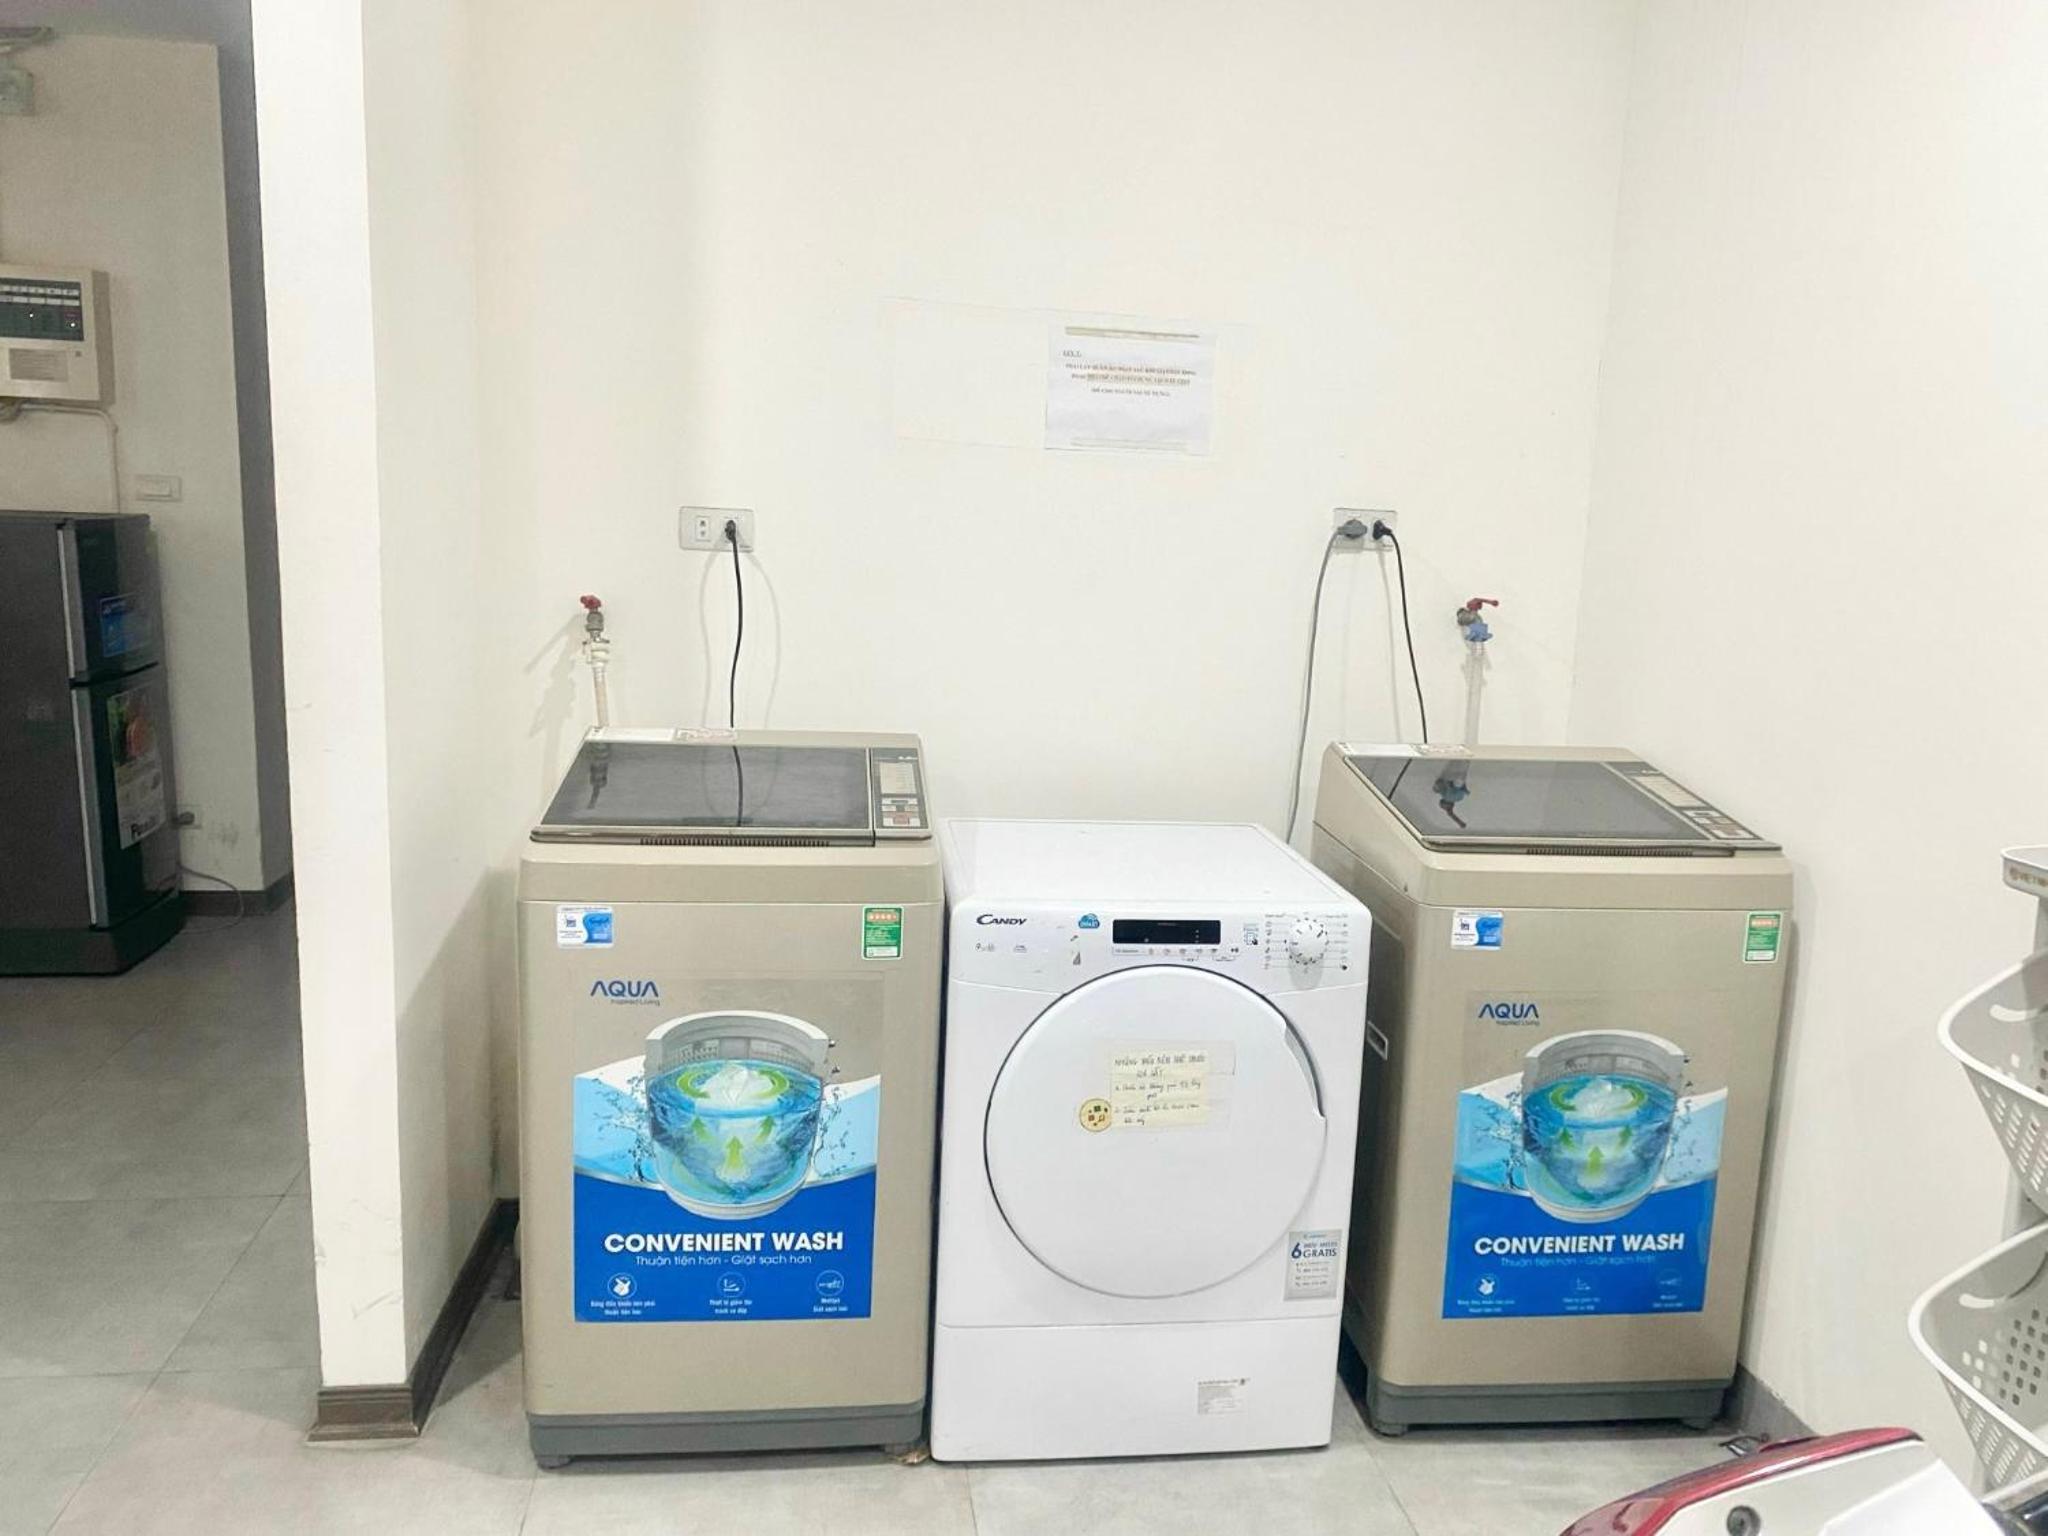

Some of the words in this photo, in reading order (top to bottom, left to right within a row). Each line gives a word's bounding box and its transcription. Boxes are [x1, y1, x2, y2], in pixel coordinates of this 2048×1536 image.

[590, 980, 659, 998] AQUA
[1478, 1003, 1540, 1019] AQUA
[604, 1232, 766, 1253] CONVENIENT
[771, 1230, 844, 1251] WASH
[1474, 1234, 1617, 1256] CONVENIENT
[1622, 1232, 1685, 1252] WASH
[1291, 1242, 1302, 1259] 6
[1303, 1247, 1338, 1258] GRATIS
[674, 1255, 696, 1267] tiện
[698, 1255, 722, 1266] hơn
[731, 1254, 756, 1266] Giặt
[759, 1253, 787, 1267] sạch
[789, 1254, 812, 1265] hơn
